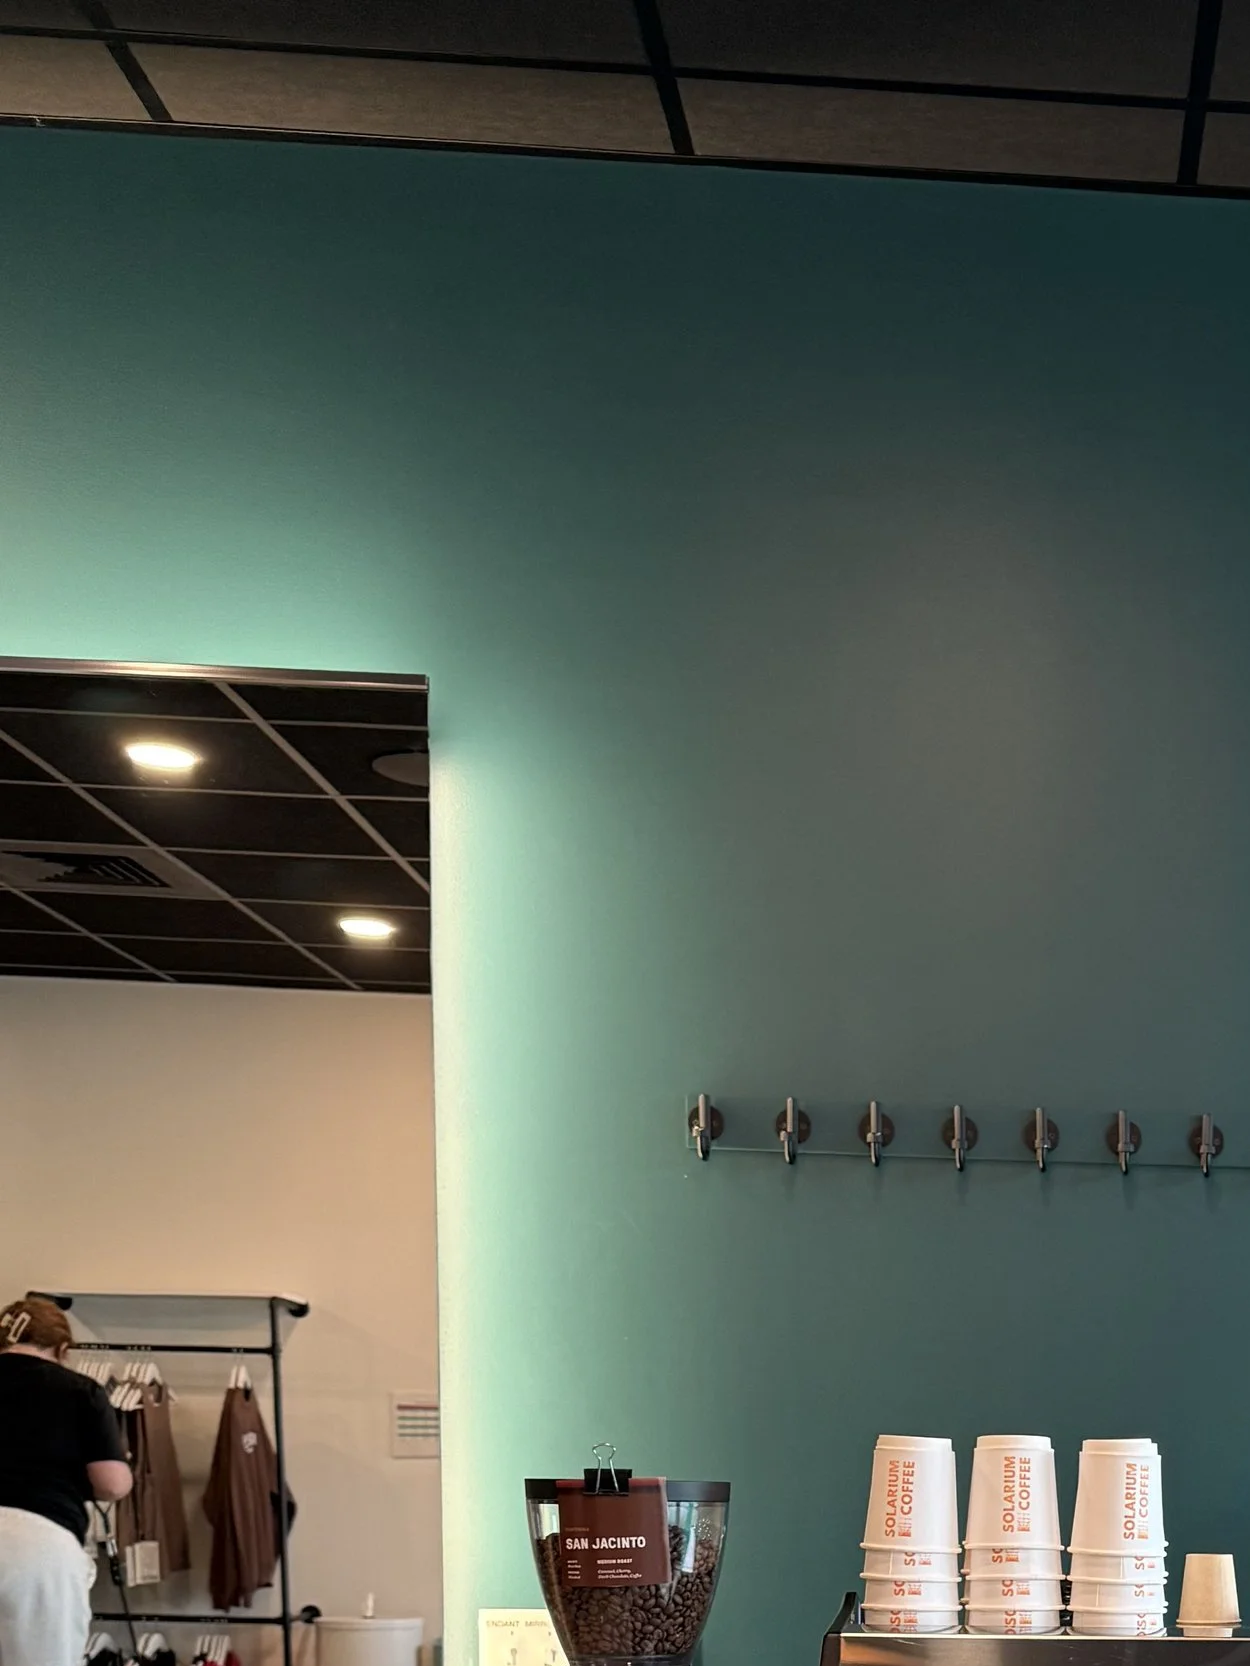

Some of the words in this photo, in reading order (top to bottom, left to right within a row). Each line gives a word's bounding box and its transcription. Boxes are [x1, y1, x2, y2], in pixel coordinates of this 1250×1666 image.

[884, 1460, 900, 1537] SOLARIUM
[900, 1461, 916, 1515] COFFEE
[1002, 1456, 1016, 1533] SOLARIUM
[1018, 1457, 1031, 1511] COFFEE
[1123, 1463, 1137, 1540] SOLARIUM
[1139, 1464, 1150, 1518] COFFEE
[565, 1538, 589, 1550] SAN
[592, 1536, 646, 1550] JACINTO
